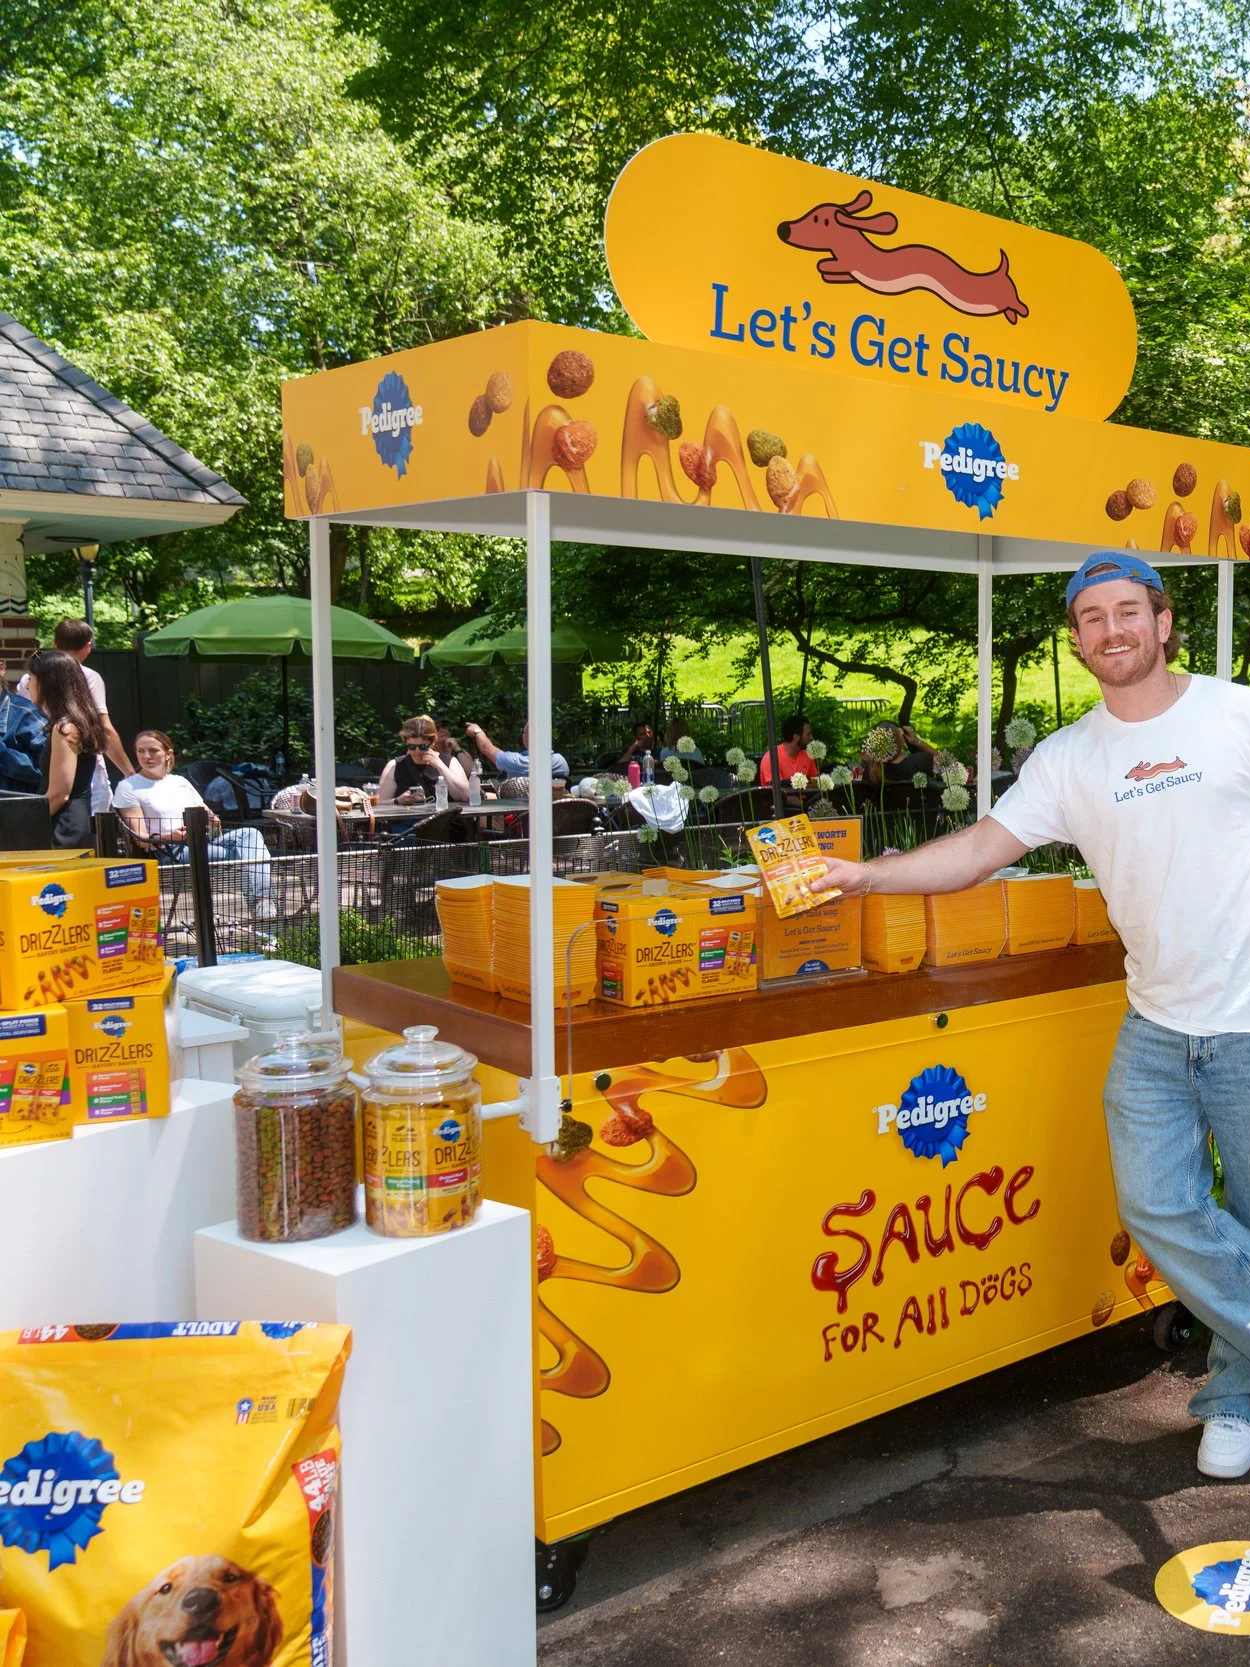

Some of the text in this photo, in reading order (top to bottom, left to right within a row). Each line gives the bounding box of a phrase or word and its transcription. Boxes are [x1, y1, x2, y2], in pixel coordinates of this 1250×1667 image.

[710, 283, 1070, 412] Let's Get Saucy
[358, 402, 424, 438] Pedigree
[923, 441, 1020, 483] Pedigree
[1114, 771, 1203, 803] Let's Get Saucy
[817, 830, 847, 839] WORTH
[759, 835, 815, 863] DRIZZLERS
[30, 892, 74, 907] Pedigree
[647, 917, 683, 927] Pedigree
[784, 923, 841, 937] Let's Get Saucy!
[20, 924, 91, 954] DRIZZLERS
[636, 941, 694, 963] DRIZZLERS
[947, 947, 993, 959] Let's Get Saucy
[93, 1020, 133, 1031] Pedigree
[75, 1042, 153, 1064] DRIZZLERS
[877, 1093, 987, 1135] Pedigree
[822, 1312, 885, 1362] FOR
[959, 1262, 1033, 1316] DOGS
[172, 1321, 239, 1336] ADULT
[257, 1403, 277, 1411] USA
